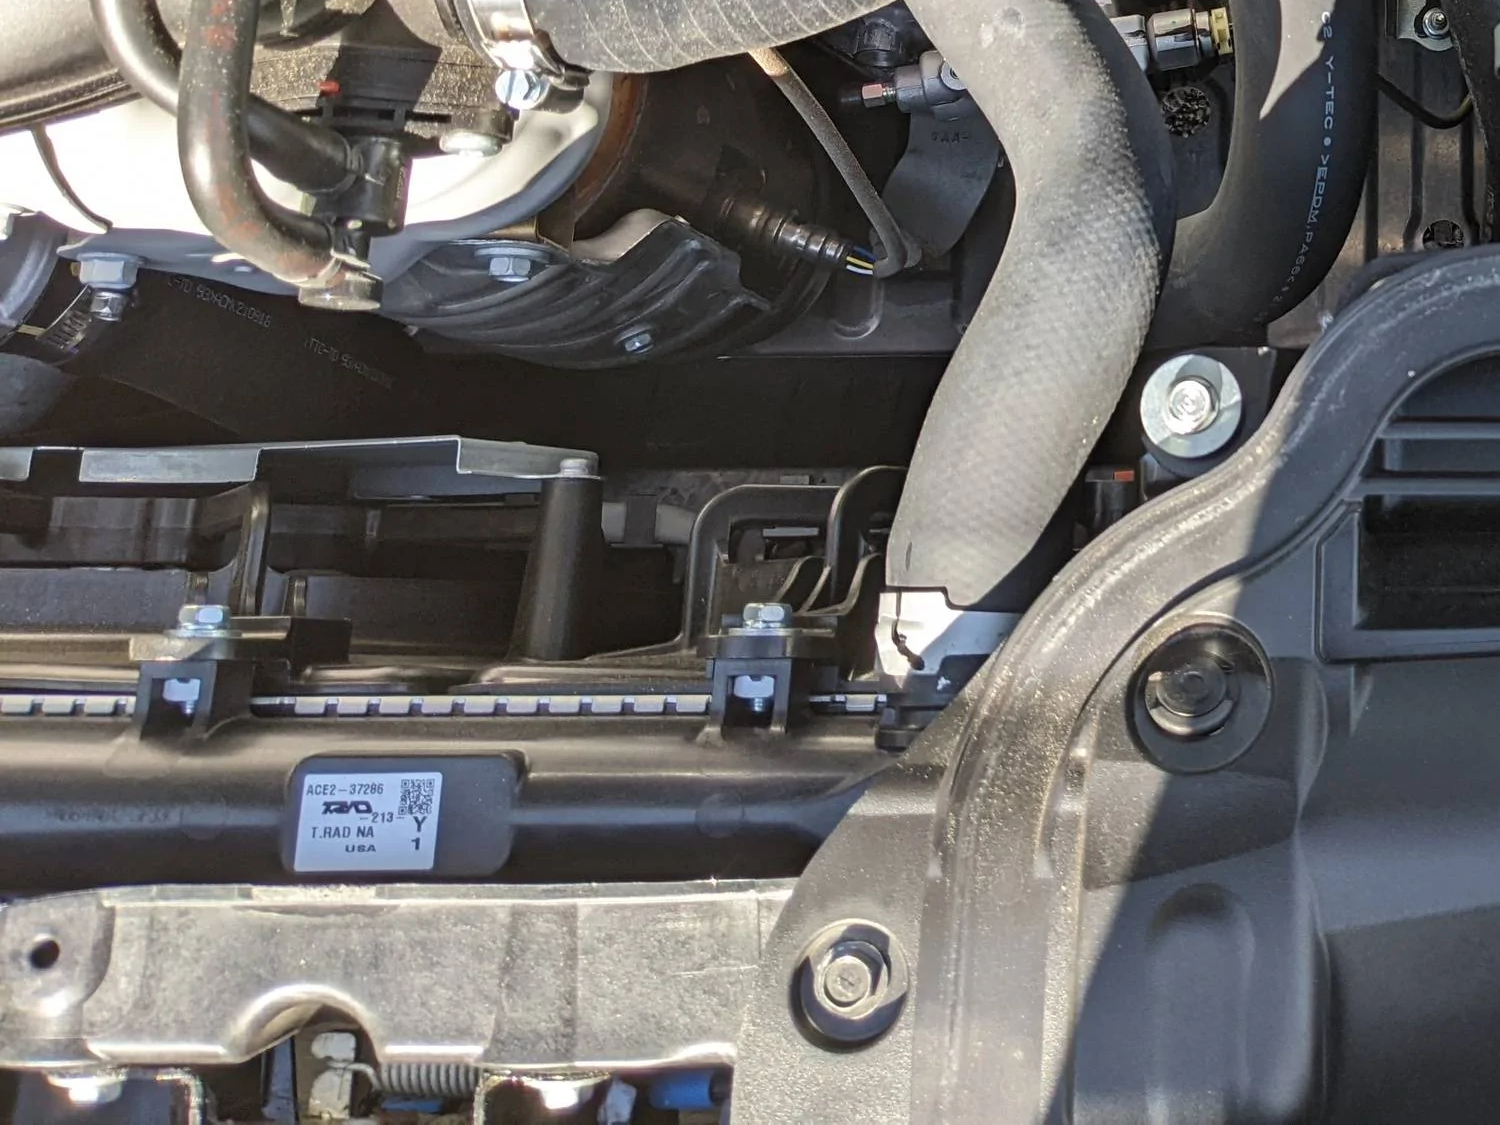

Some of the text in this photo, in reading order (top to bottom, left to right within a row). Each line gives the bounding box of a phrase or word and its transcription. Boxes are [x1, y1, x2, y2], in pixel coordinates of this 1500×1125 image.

[1324, 55, 1337, 130] Y-TEC
[413, 816, 428, 832] Y
[311, 826, 374, 839] T.RAD NA
[344, 844, 377, 853] USA
[411, 838, 421, 851] 1
